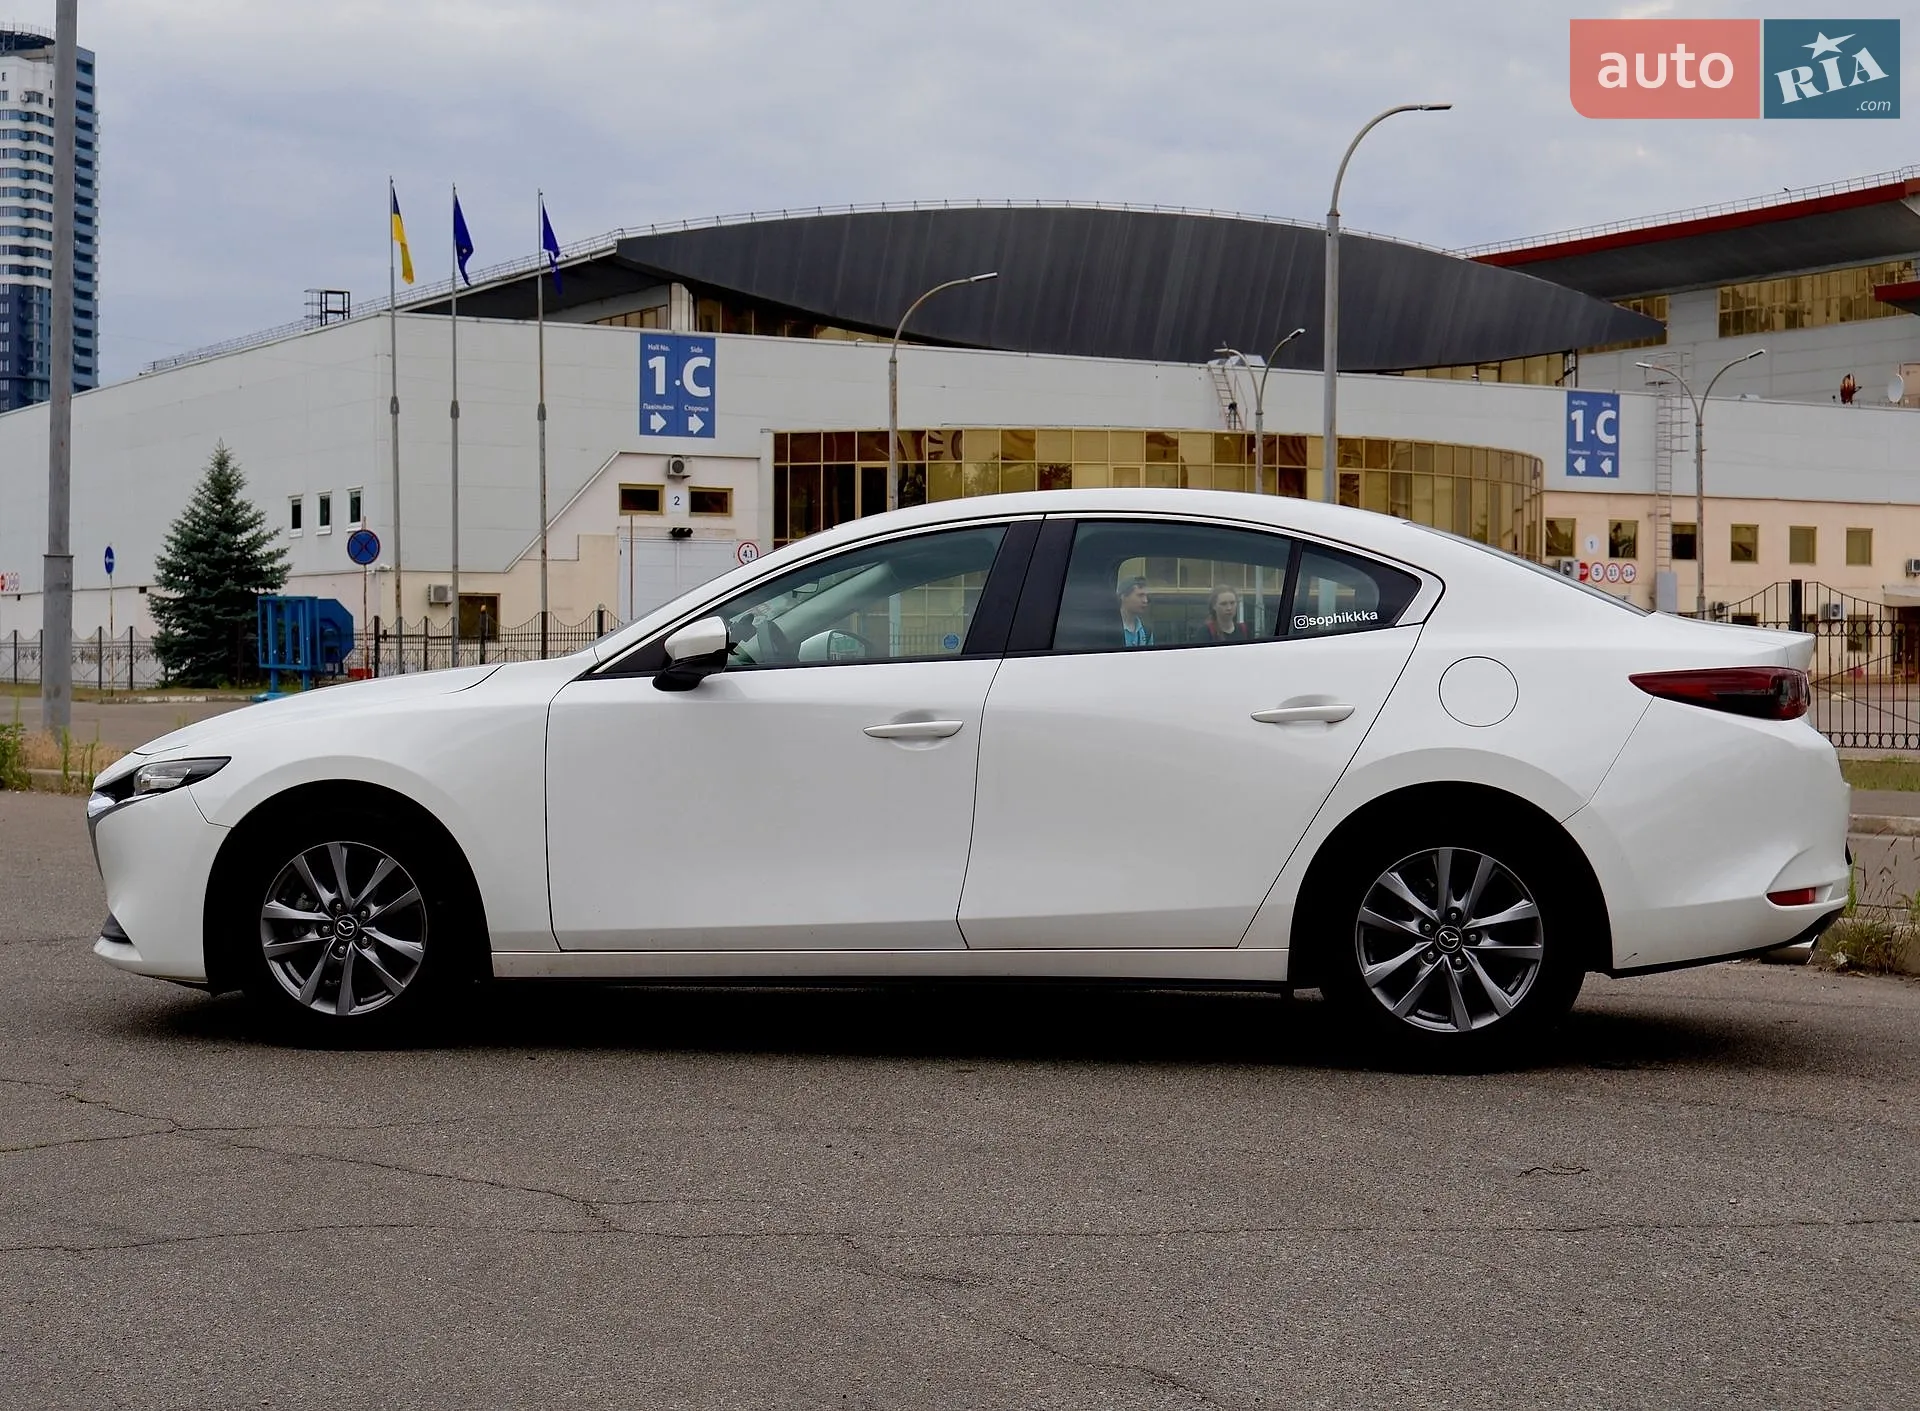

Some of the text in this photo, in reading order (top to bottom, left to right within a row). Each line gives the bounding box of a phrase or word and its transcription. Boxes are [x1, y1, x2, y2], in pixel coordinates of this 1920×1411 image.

[690, 346, 703, 354] Side
[674, 495, 680, 506] 2
[1308, 610, 1379, 627] sophikkka
